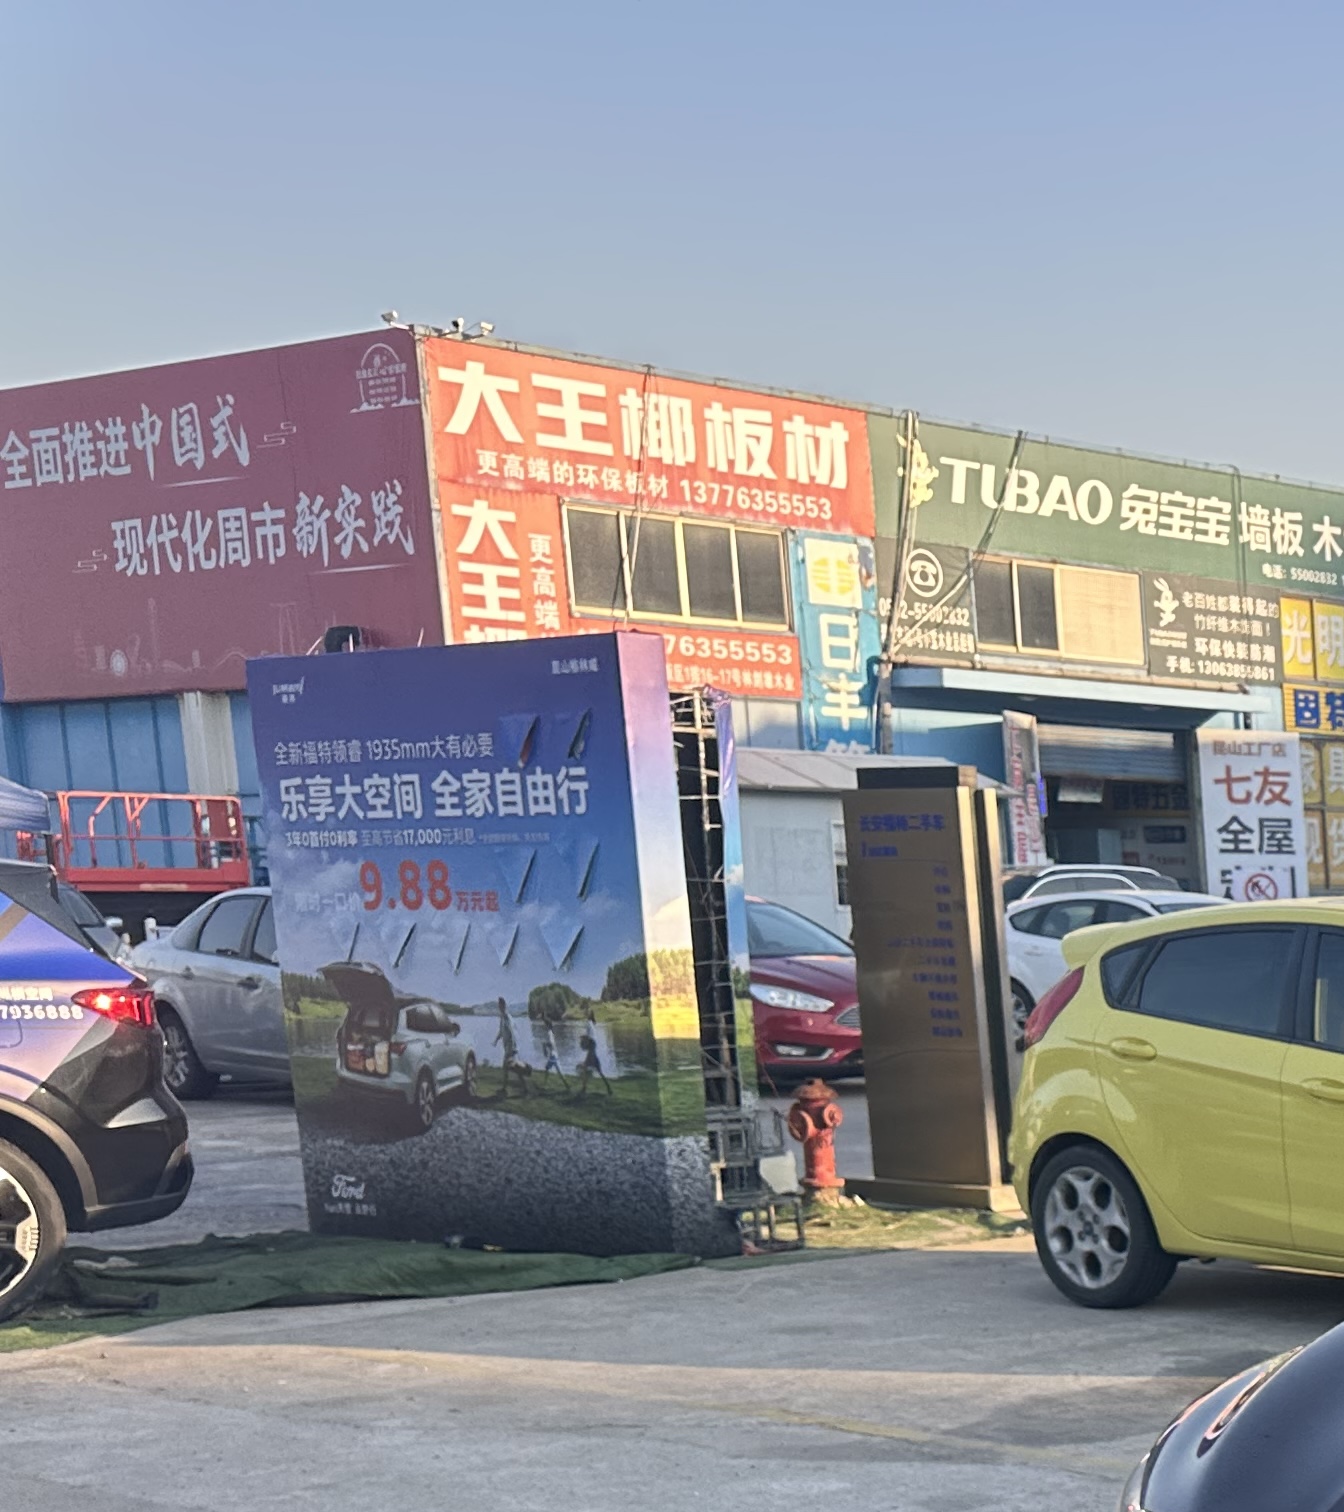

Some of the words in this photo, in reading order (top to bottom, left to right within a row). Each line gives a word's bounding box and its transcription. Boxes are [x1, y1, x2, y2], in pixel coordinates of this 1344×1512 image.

[0, 393, 250, 490] 全面推进中国式
[438, 360, 849, 490] 大王椰板材
[476, 448, 669, 499] 更高端的环保板材
[680, 479, 832, 521] 13776355553
[939, 456, 1113, 526] TUBAO
[1119, 483, 1230, 545] 兔宝宝
[1239, 502, 1304, 558] 墙板
[112, 478, 415, 577] 现代化周市新实践
[527, 532, 561, 638] 更高端
[818, 613, 869, 754] 日丰
[366, 732, 494, 762] 1935mm大有必要
[1214, 765, 1292, 807] 七友
[279, 772, 424, 823] 乐享大空间
[431, 766, 590, 819] 全家自由行
[1216, 815, 1296, 857] 全屋
[359, 859, 453, 912] 9.88
